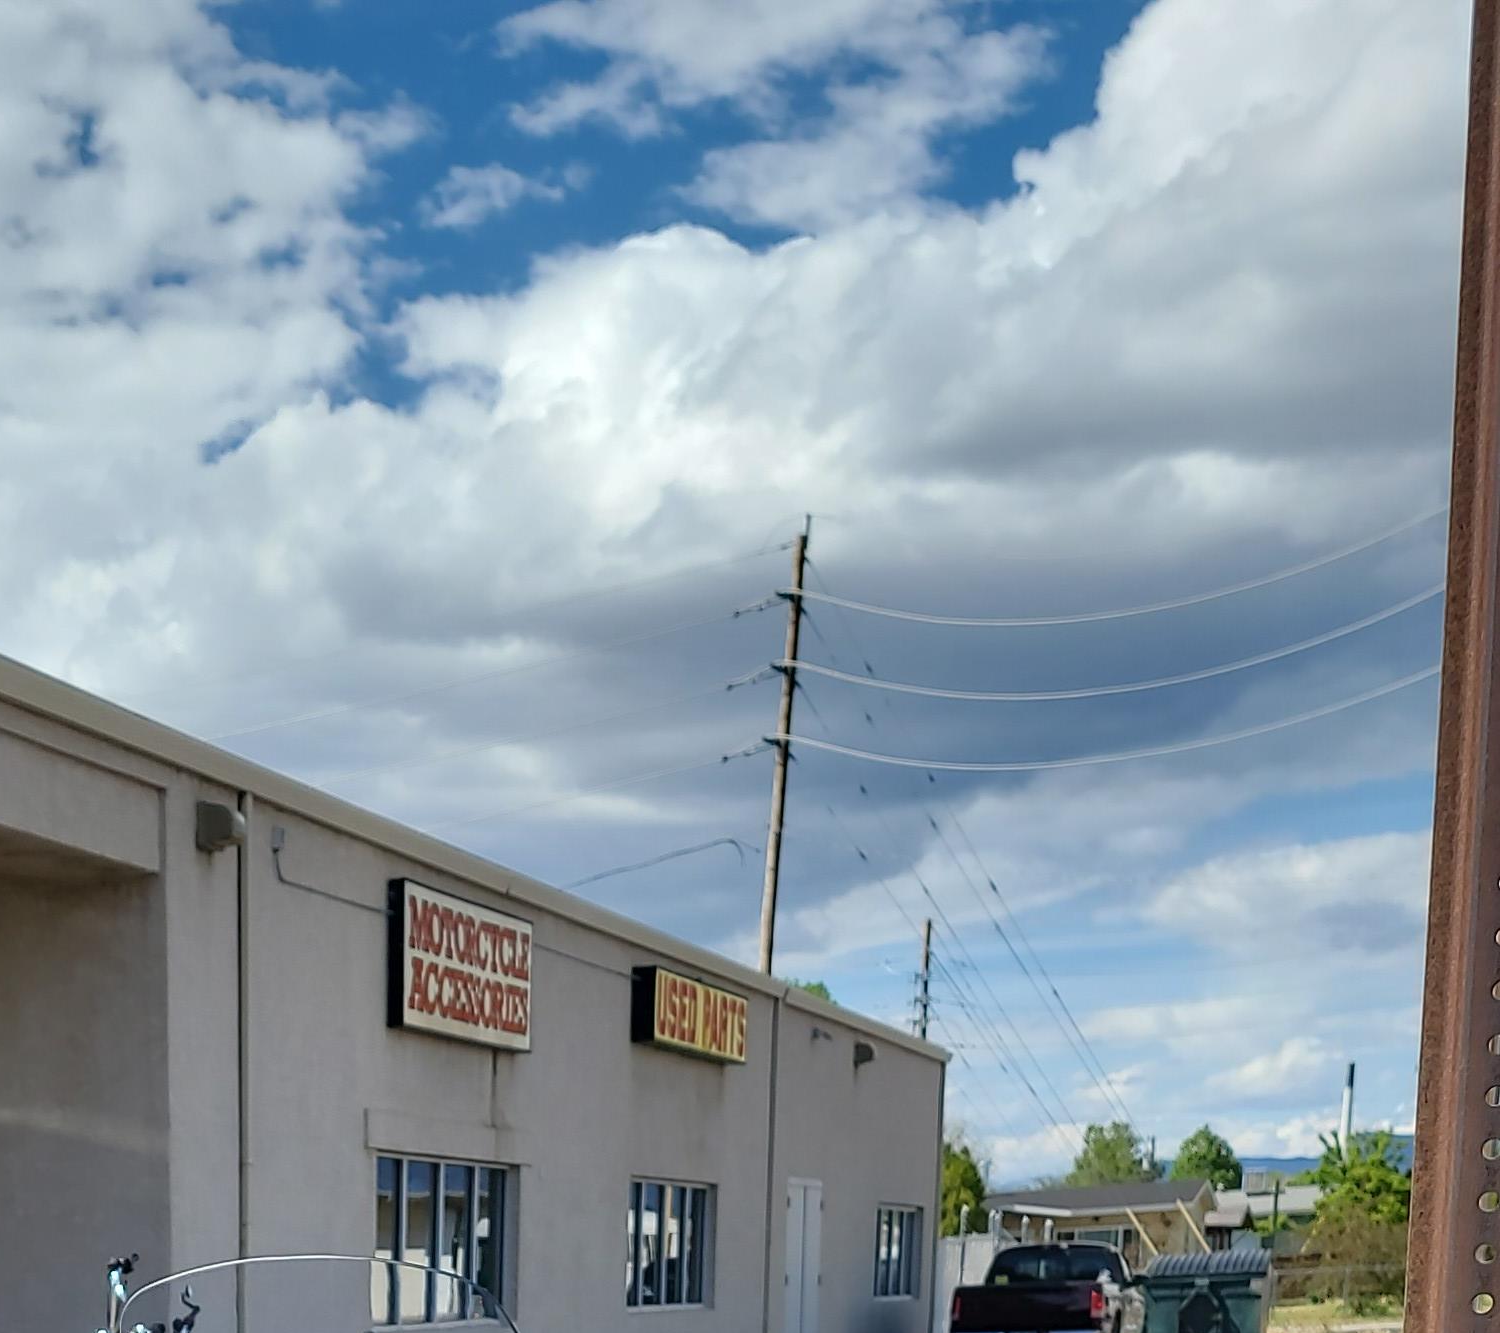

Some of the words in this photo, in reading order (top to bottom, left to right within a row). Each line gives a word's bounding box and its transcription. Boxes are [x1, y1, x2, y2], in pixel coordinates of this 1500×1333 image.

[408, 894, 531, 981] MOTORCYCLE
[408, 956, 529, 1036] ACCESSORIES
[656, 972, 697, 1045] USED
[702, 986, 745, 1057] PARTS
